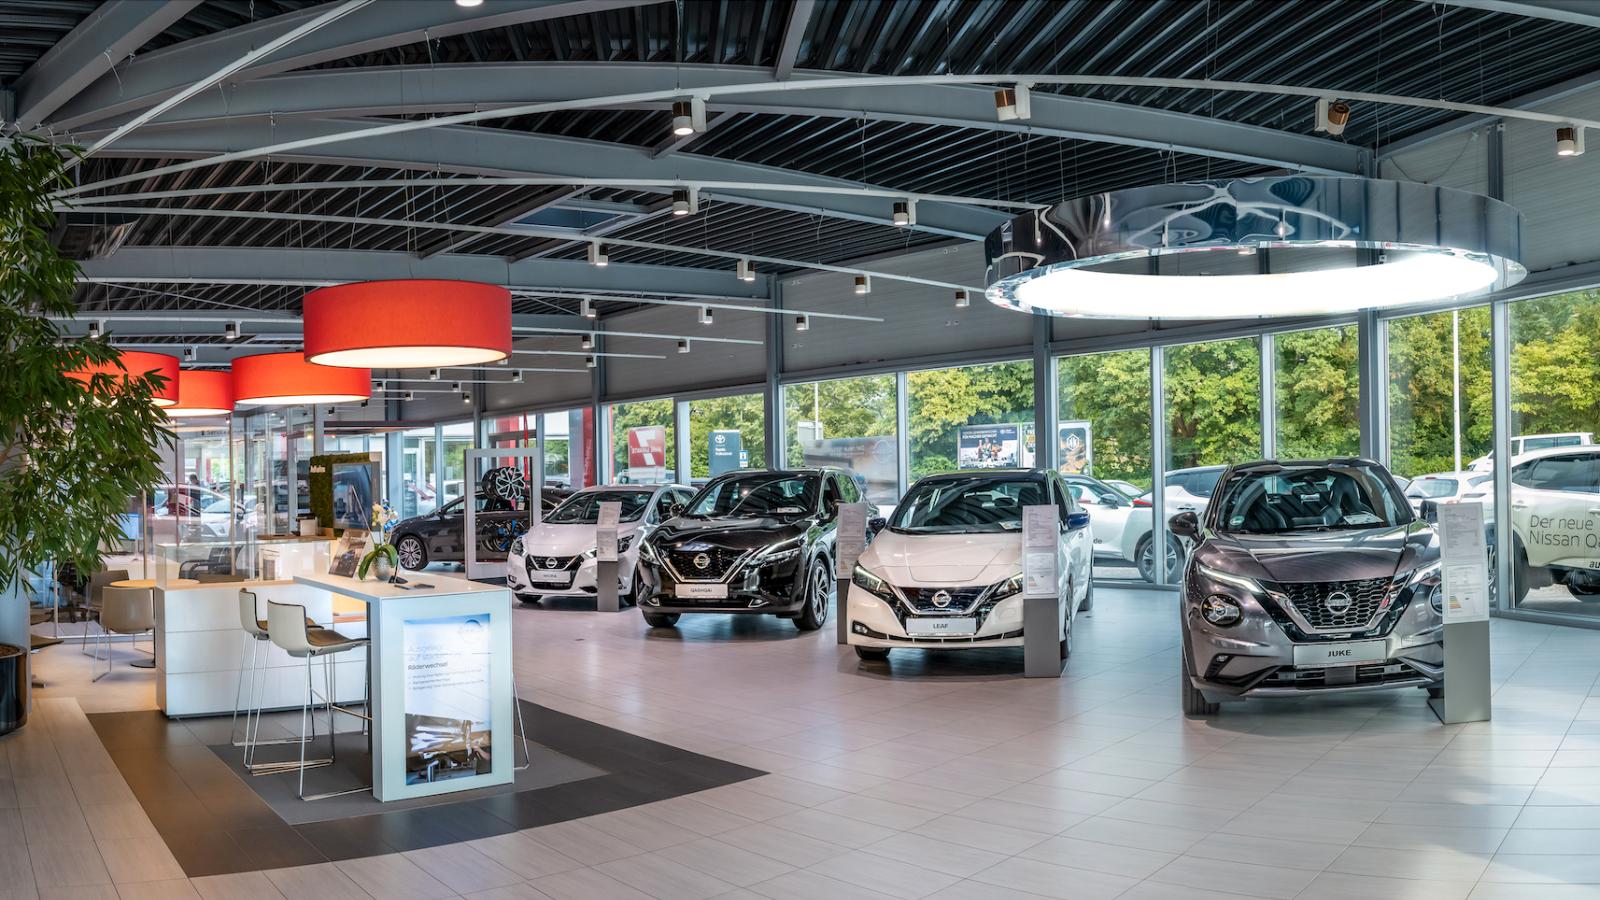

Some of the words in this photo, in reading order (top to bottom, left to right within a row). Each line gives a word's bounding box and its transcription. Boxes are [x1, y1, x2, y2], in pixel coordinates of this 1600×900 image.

[1530, 514, 1554, 529] Der
[1558, 518, 1594, 531] neue
[1529, 530, 1580, 547] Nissan
[1327, 649, 1353, 658] JUKE
